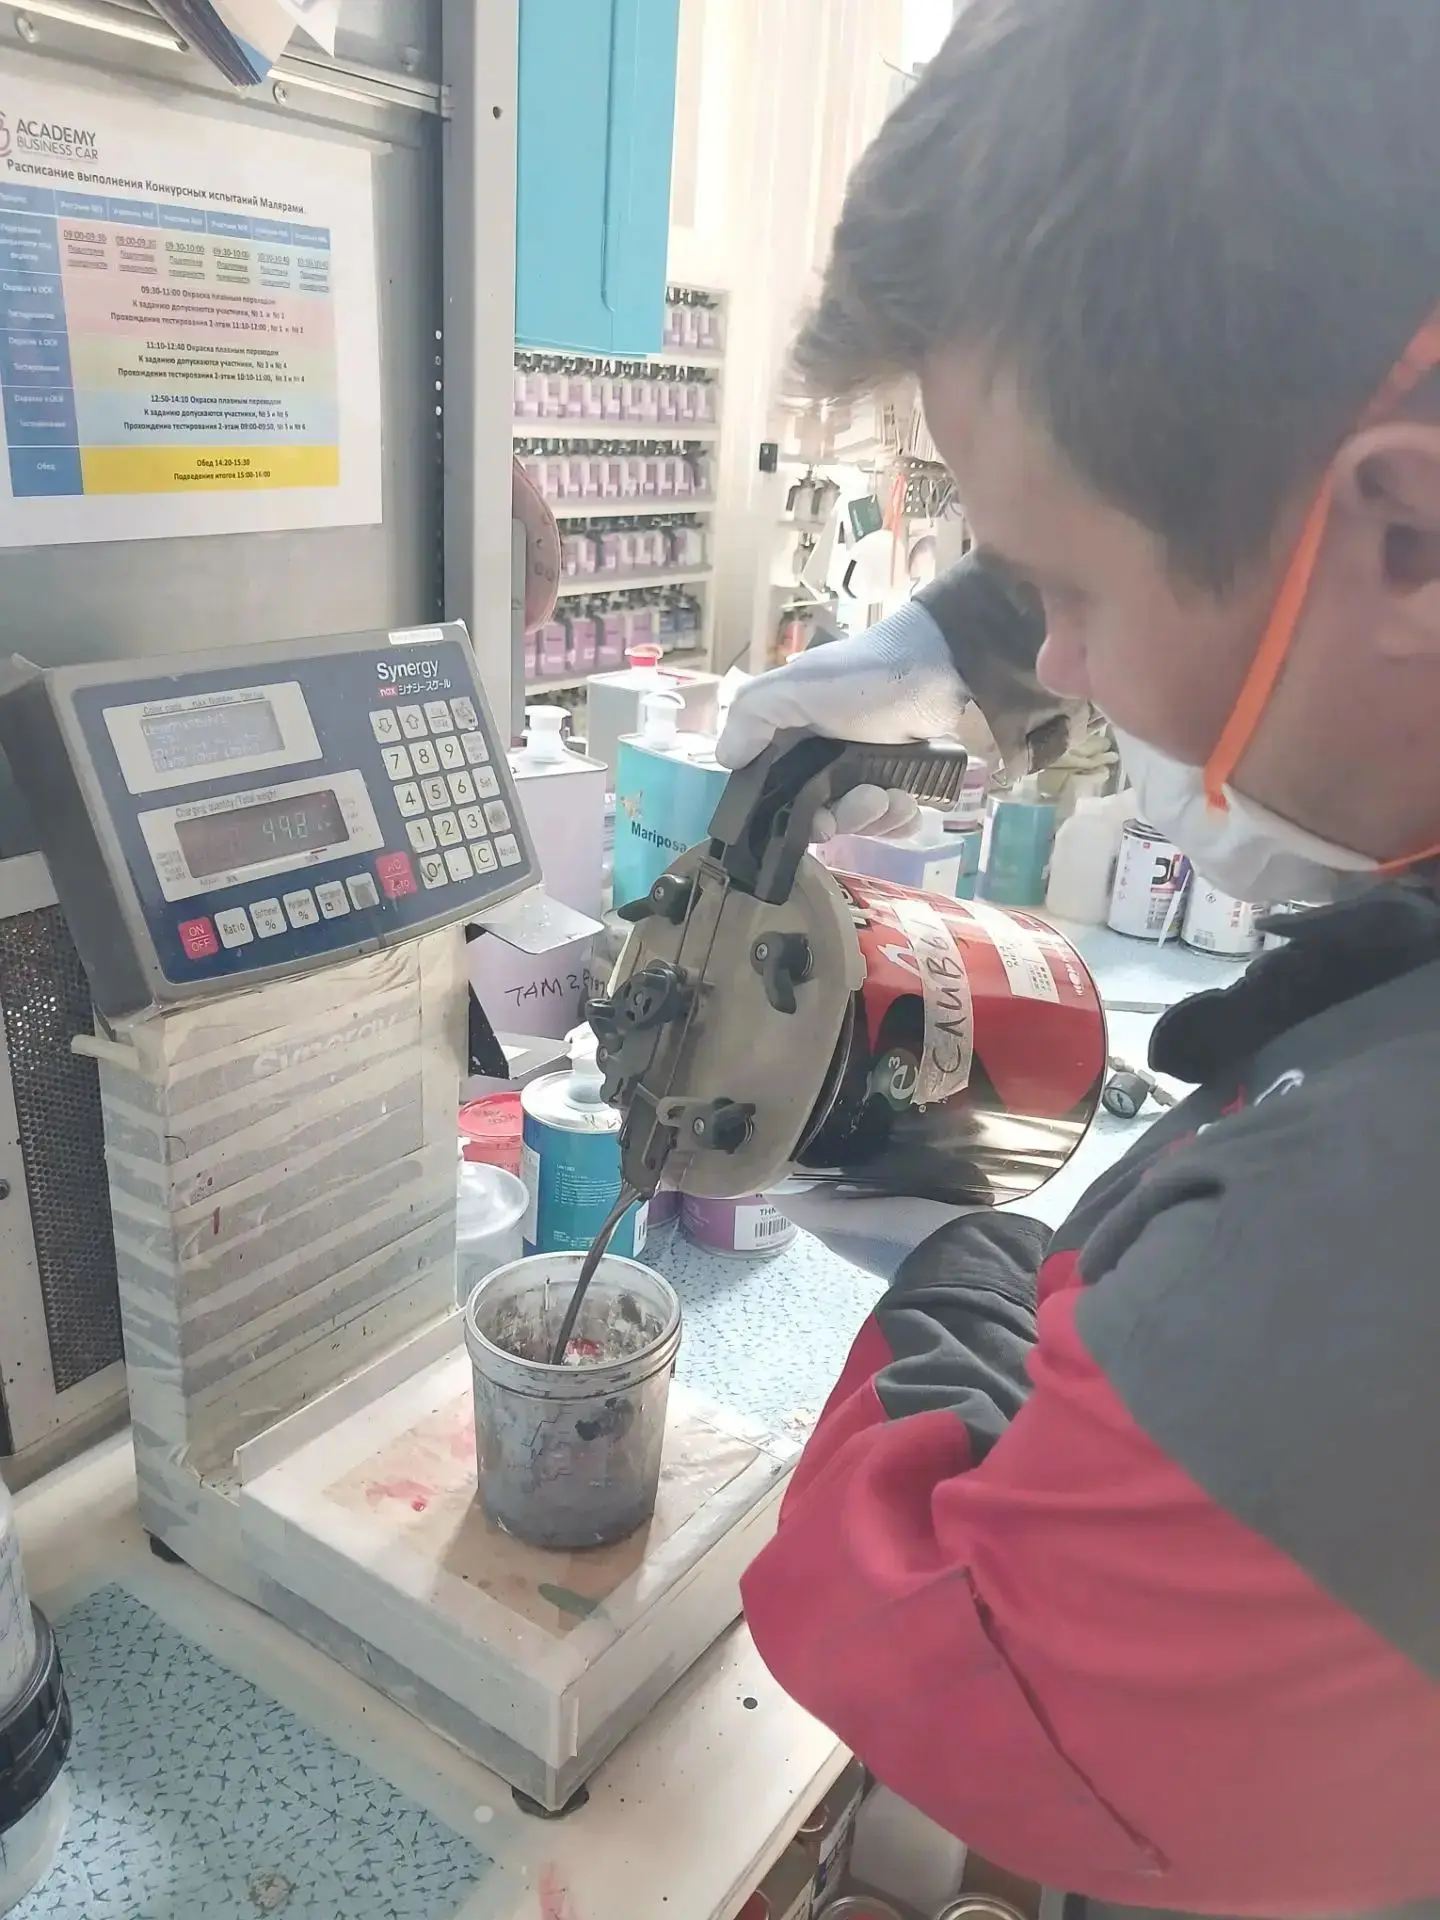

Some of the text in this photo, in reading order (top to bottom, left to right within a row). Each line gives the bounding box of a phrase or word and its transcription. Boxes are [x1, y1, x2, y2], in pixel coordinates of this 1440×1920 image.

[16, 118, 97, 147] ACADEMY
[16, 136, 99, 160] BUSINESS CAR
[6, 158, 75, 181] Расписание
[77, 173, 143, 190] выполнения
[145, 180, 207, 200] Конкурсных
[208, 190, 259, 207] испытаний
[182, 289, 211, 300] Окраска
[139, 301, 170, 312] заданию
[171, 303, 215, 314] допускаются
[110, 312, 161, 324] Прохождение
[162, 316, 208, 328] тестирования
[186, 343, 214, 354] Окраска
[145, 356, 175, 366] заданию
[176, 357, 220, 369] допускаются
[118, 367, 167, 379] Прохождение
[168, 370, 214, 381] тестирования
[190, 396, 217, 405] Окраска
[218, 397, 247, 405] плавным
[150, 409, 180, 418] заданию
[181, 410, 223, 419] допускаются
[124, 422, 172, 432] Прохождение
[172, 423, 217, 432] тестирования
[196, 459, 214, 468] Обед
[174, 472, 214, 481] Подведение
[214, 472, 235, 480] итогов
[376, 660, 439, 683] Synergy
[390, 743, 454, 770] 7 8 9
[405, 778, 467, 806] 4 5 6
[417, 813, 478, 842] 1 2 3
[630, 820, 688, 853] Mariposa
[478, 848, 490, 863] C
[188, 925, 204, 937] ON
[223, 922, 246, 935] Ratio
[265, 919, 277, 931] %
[191, 938, 210, 952] OFF
